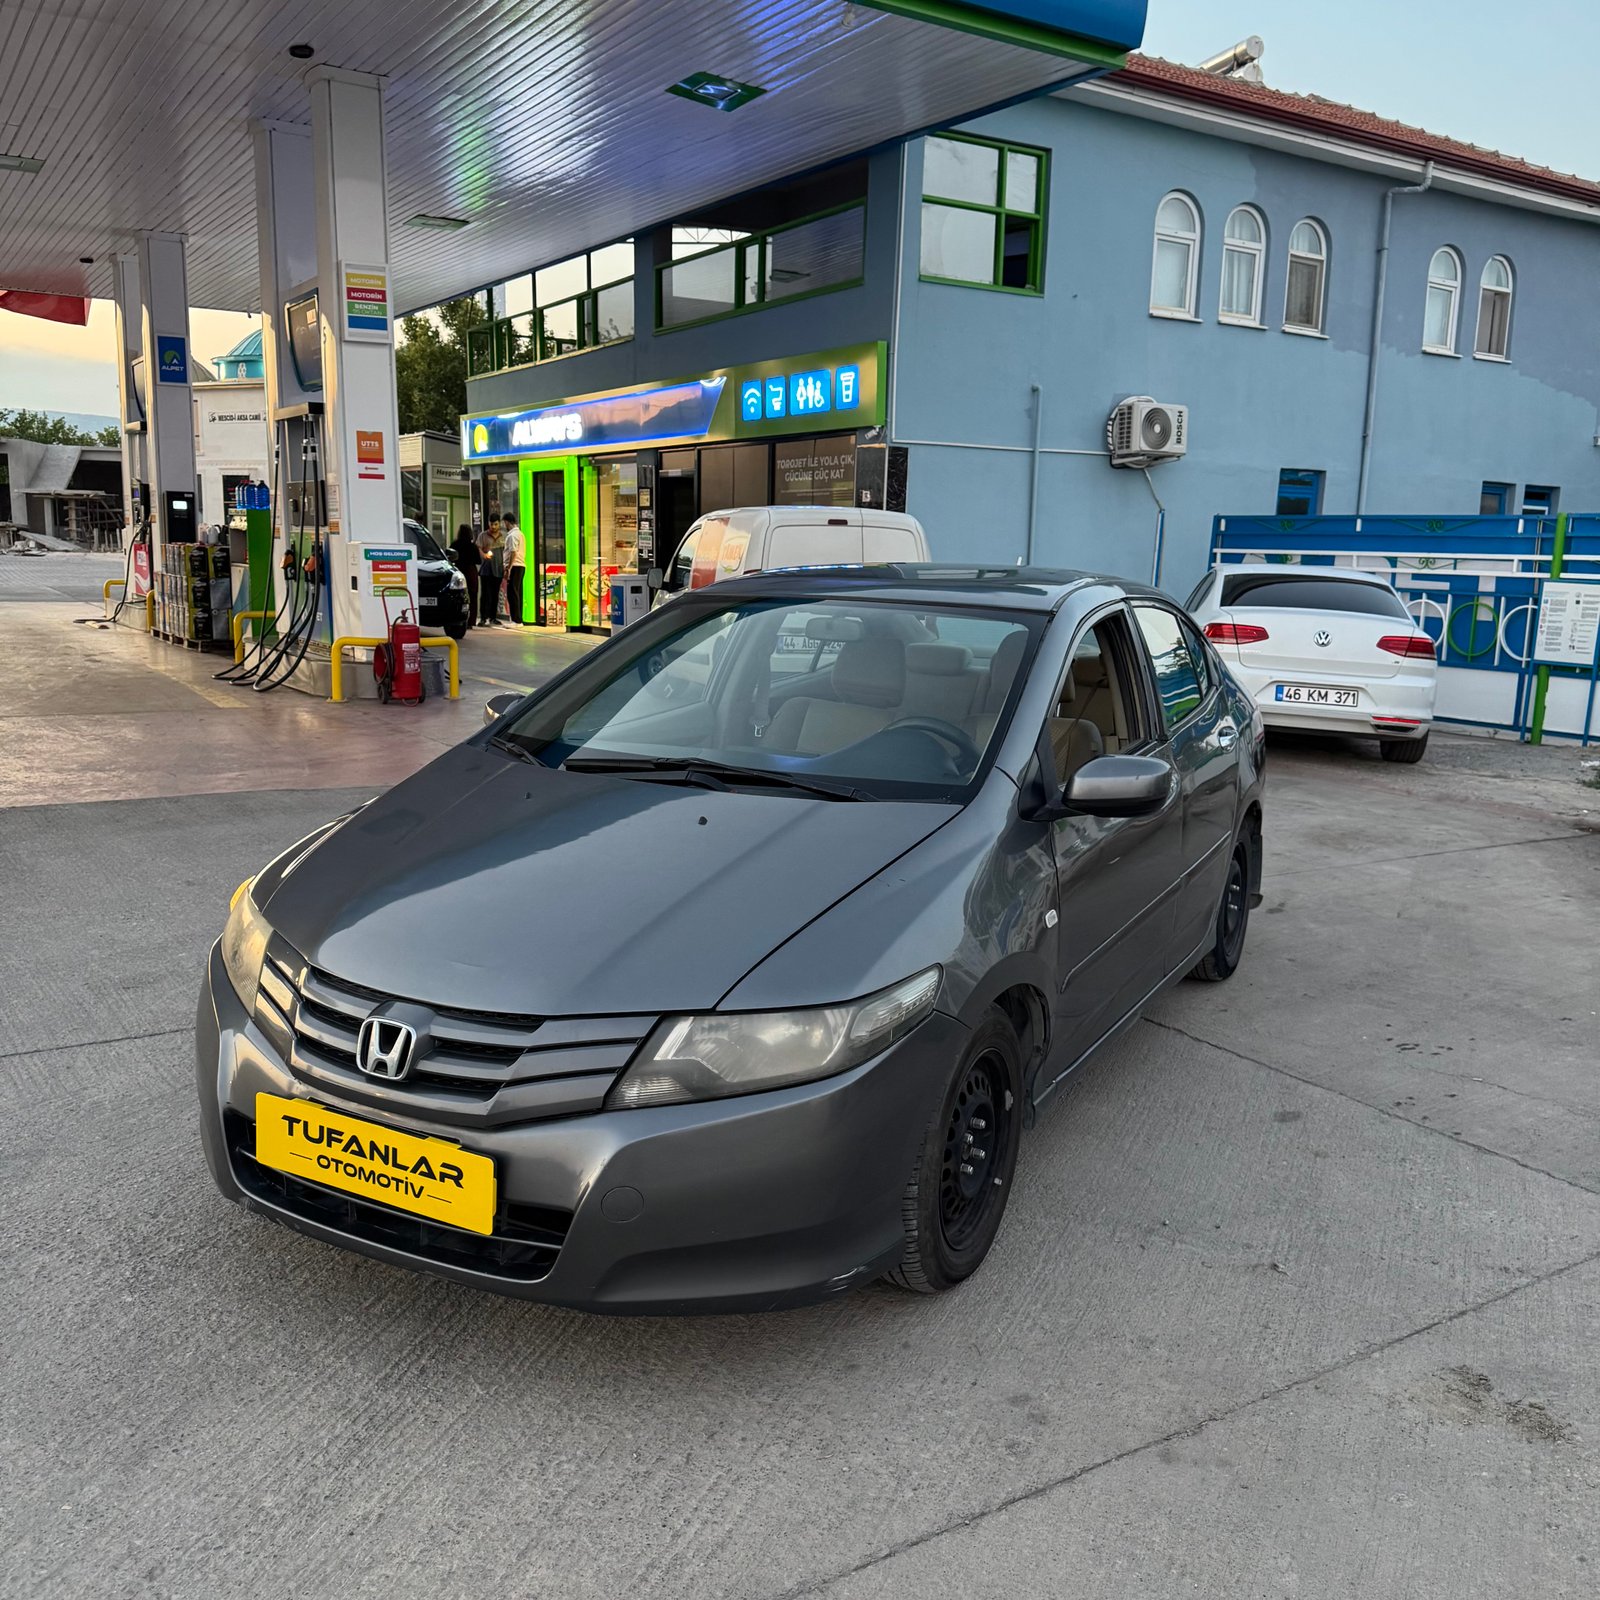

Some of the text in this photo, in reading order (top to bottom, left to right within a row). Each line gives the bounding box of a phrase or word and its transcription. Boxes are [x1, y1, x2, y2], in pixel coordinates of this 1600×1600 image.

[777, 458, 807, 469] TOROJET
[820, 455, 839, 466] YOLA
[784, 468, 845, 483] GÜCÜNE GÜÇ KAT
[1285, 688, 1301, 700] 46
[1307, 689, 1329, 702] KM
[1334, 691, 1356, 704] 371
[281, 1115, 464, 1189] TUFANLAR
[316, 1154, 425, 1199] OTOMOTİV
